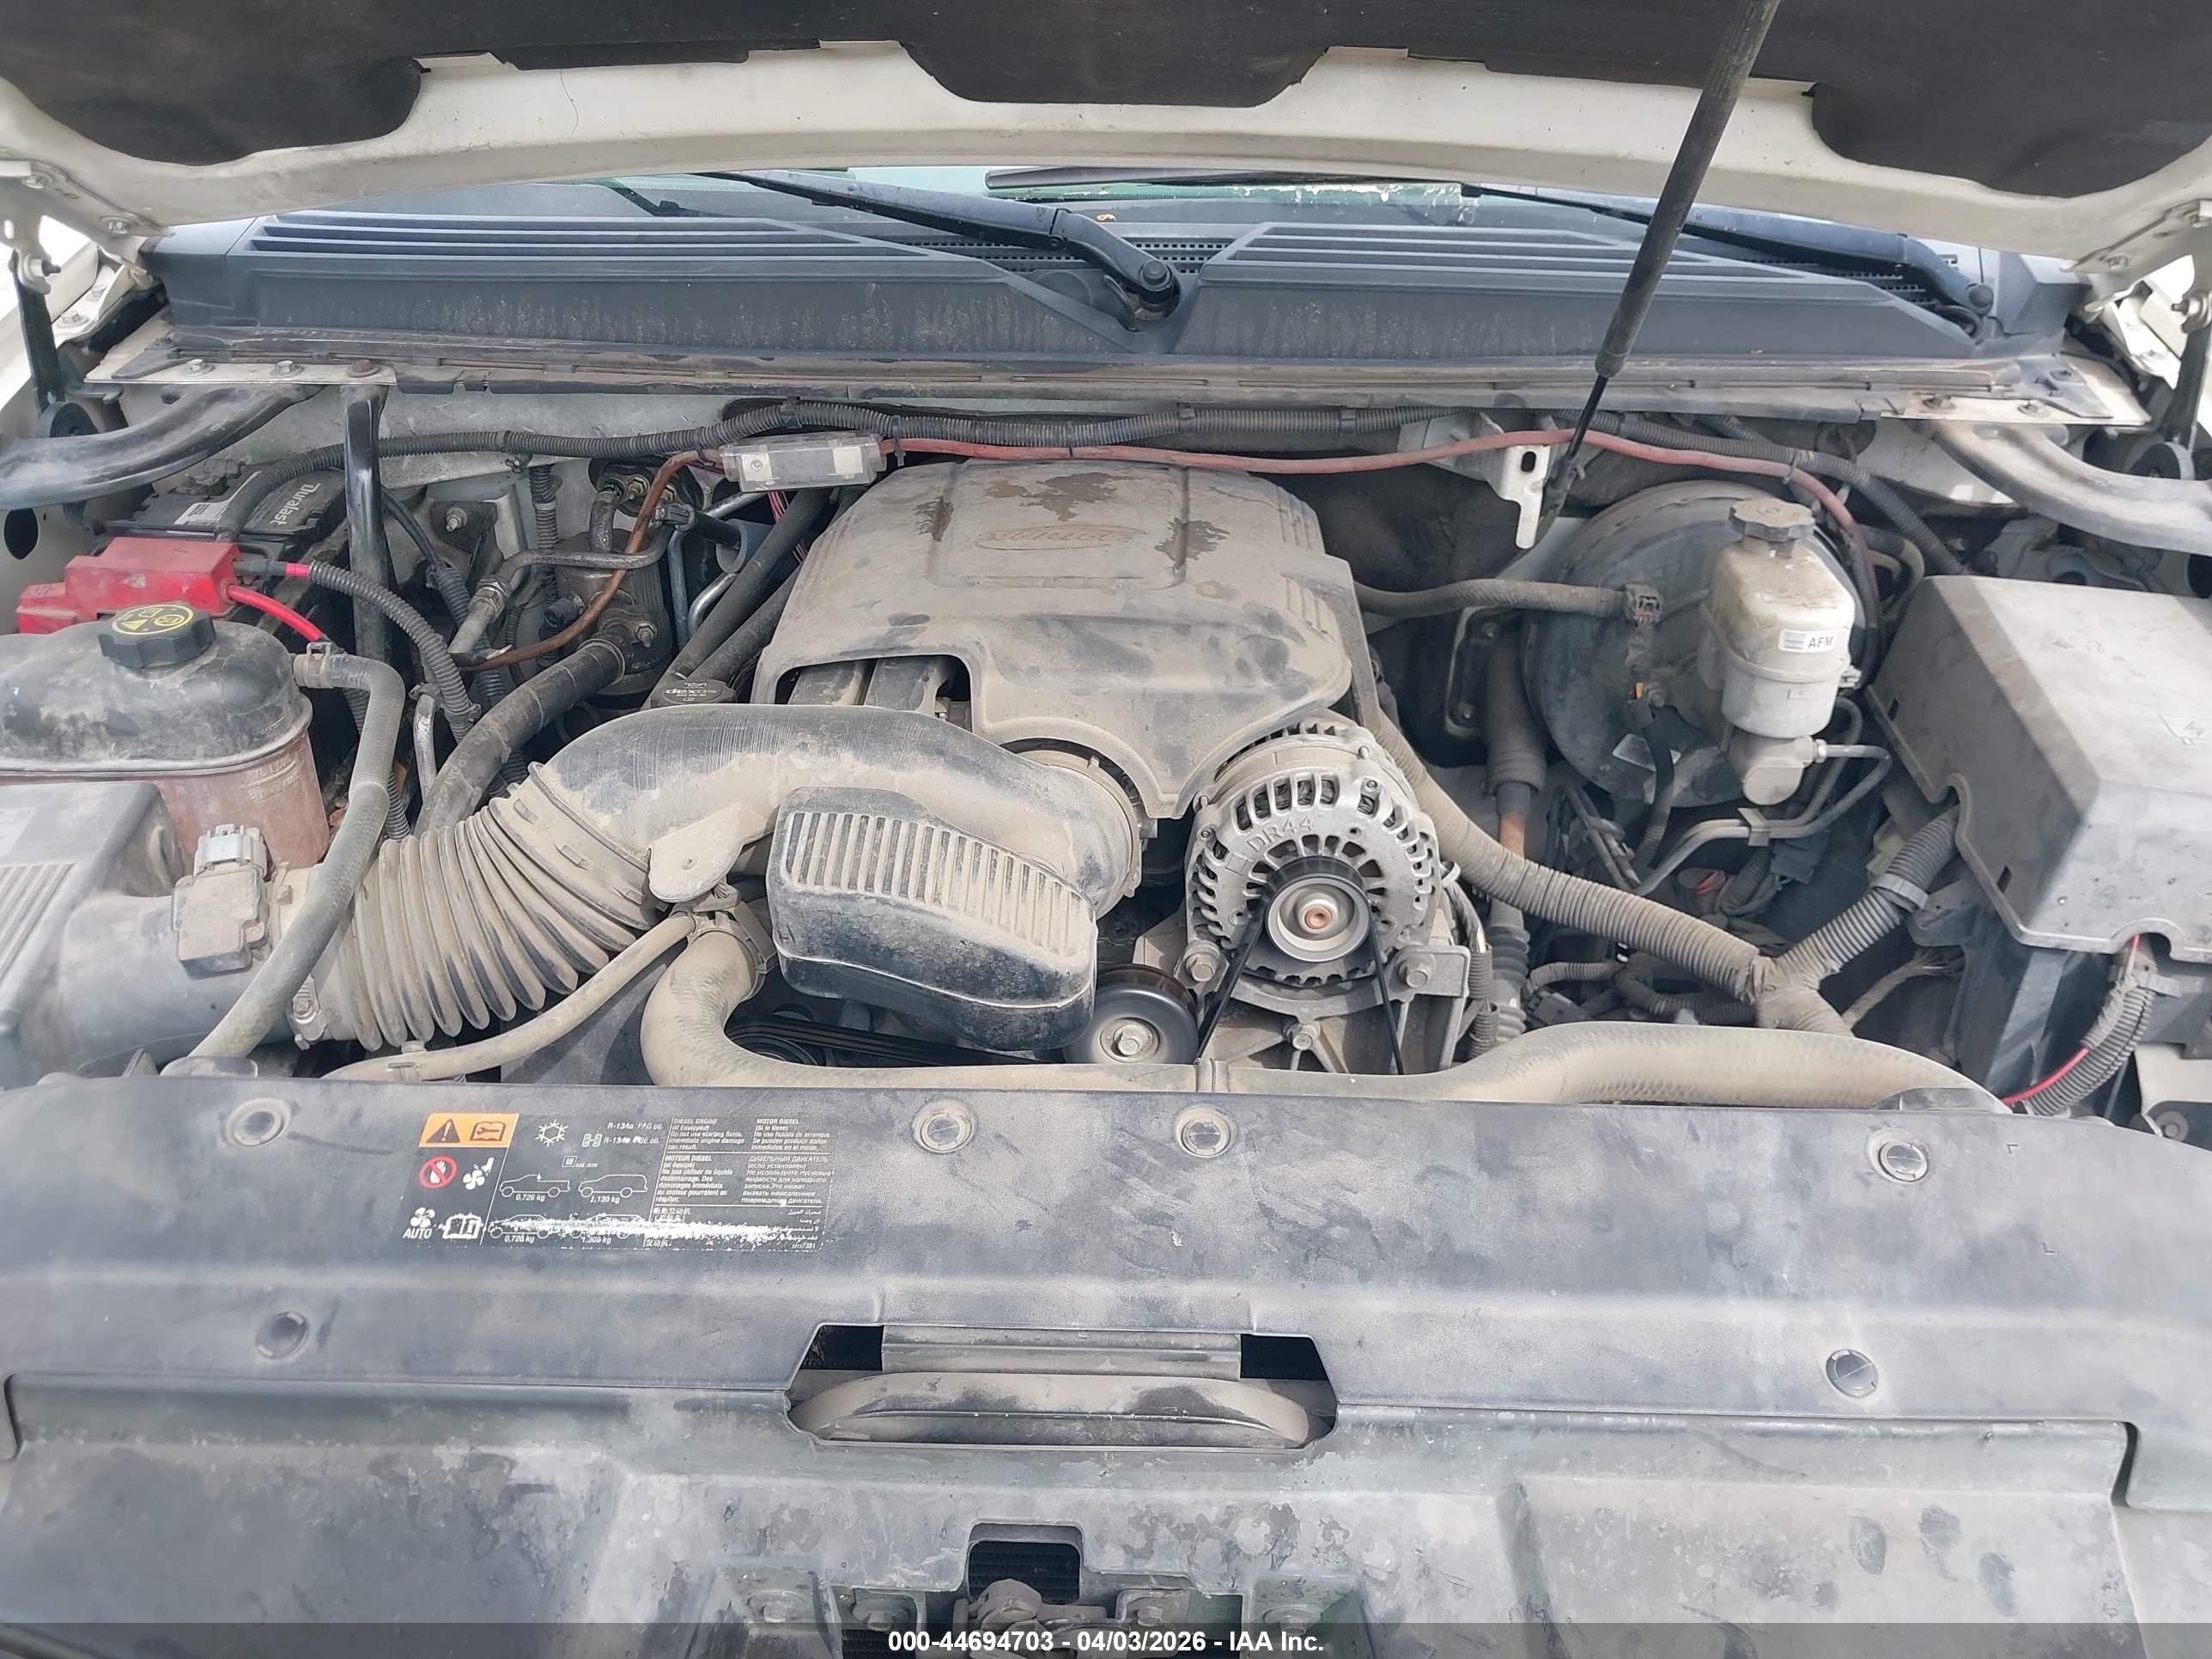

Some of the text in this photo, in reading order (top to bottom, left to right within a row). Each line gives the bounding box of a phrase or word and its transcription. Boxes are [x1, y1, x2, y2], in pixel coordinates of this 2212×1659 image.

[270, 483, 321, 525] Duralast
[1808, 636, 1833, 648] AFM
[607, 1121, 634, 1130] R-134a
[536, 1194, 545, 1202] kg
[611, 1195, 620, 1204] kg
[402, 1228, 434, 1239] AUTO
[526, 1235, 535, 1243] kg
